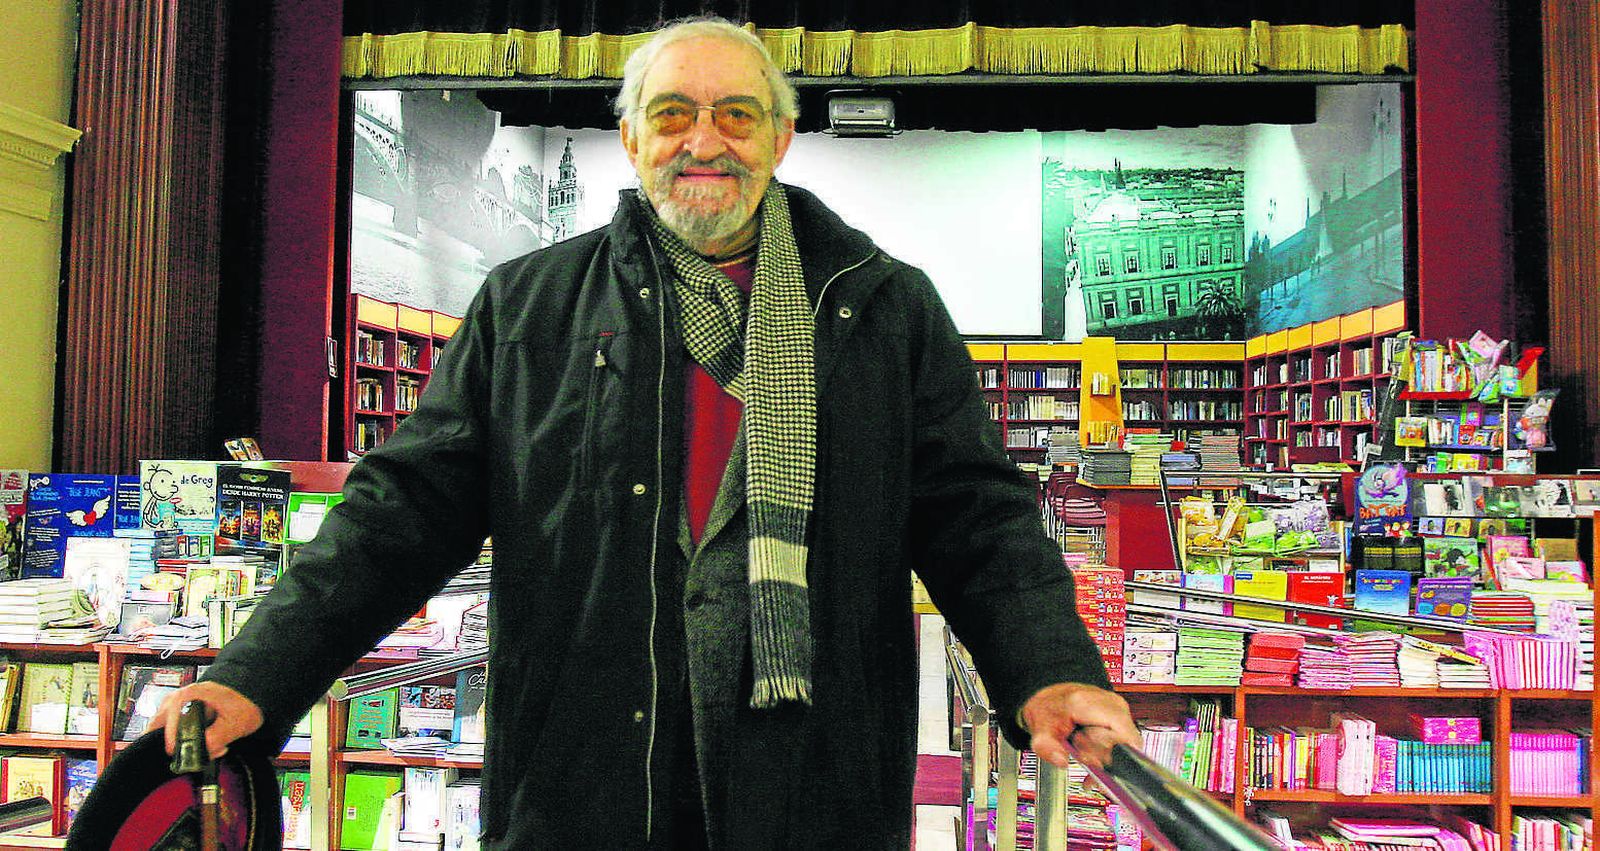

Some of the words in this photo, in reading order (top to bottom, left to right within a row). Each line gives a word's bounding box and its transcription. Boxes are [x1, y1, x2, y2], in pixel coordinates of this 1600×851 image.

[180, 475, 190, 485] de
[190, 475, 213, 488] Greg
[261, 492, 284, 500] POTTER
